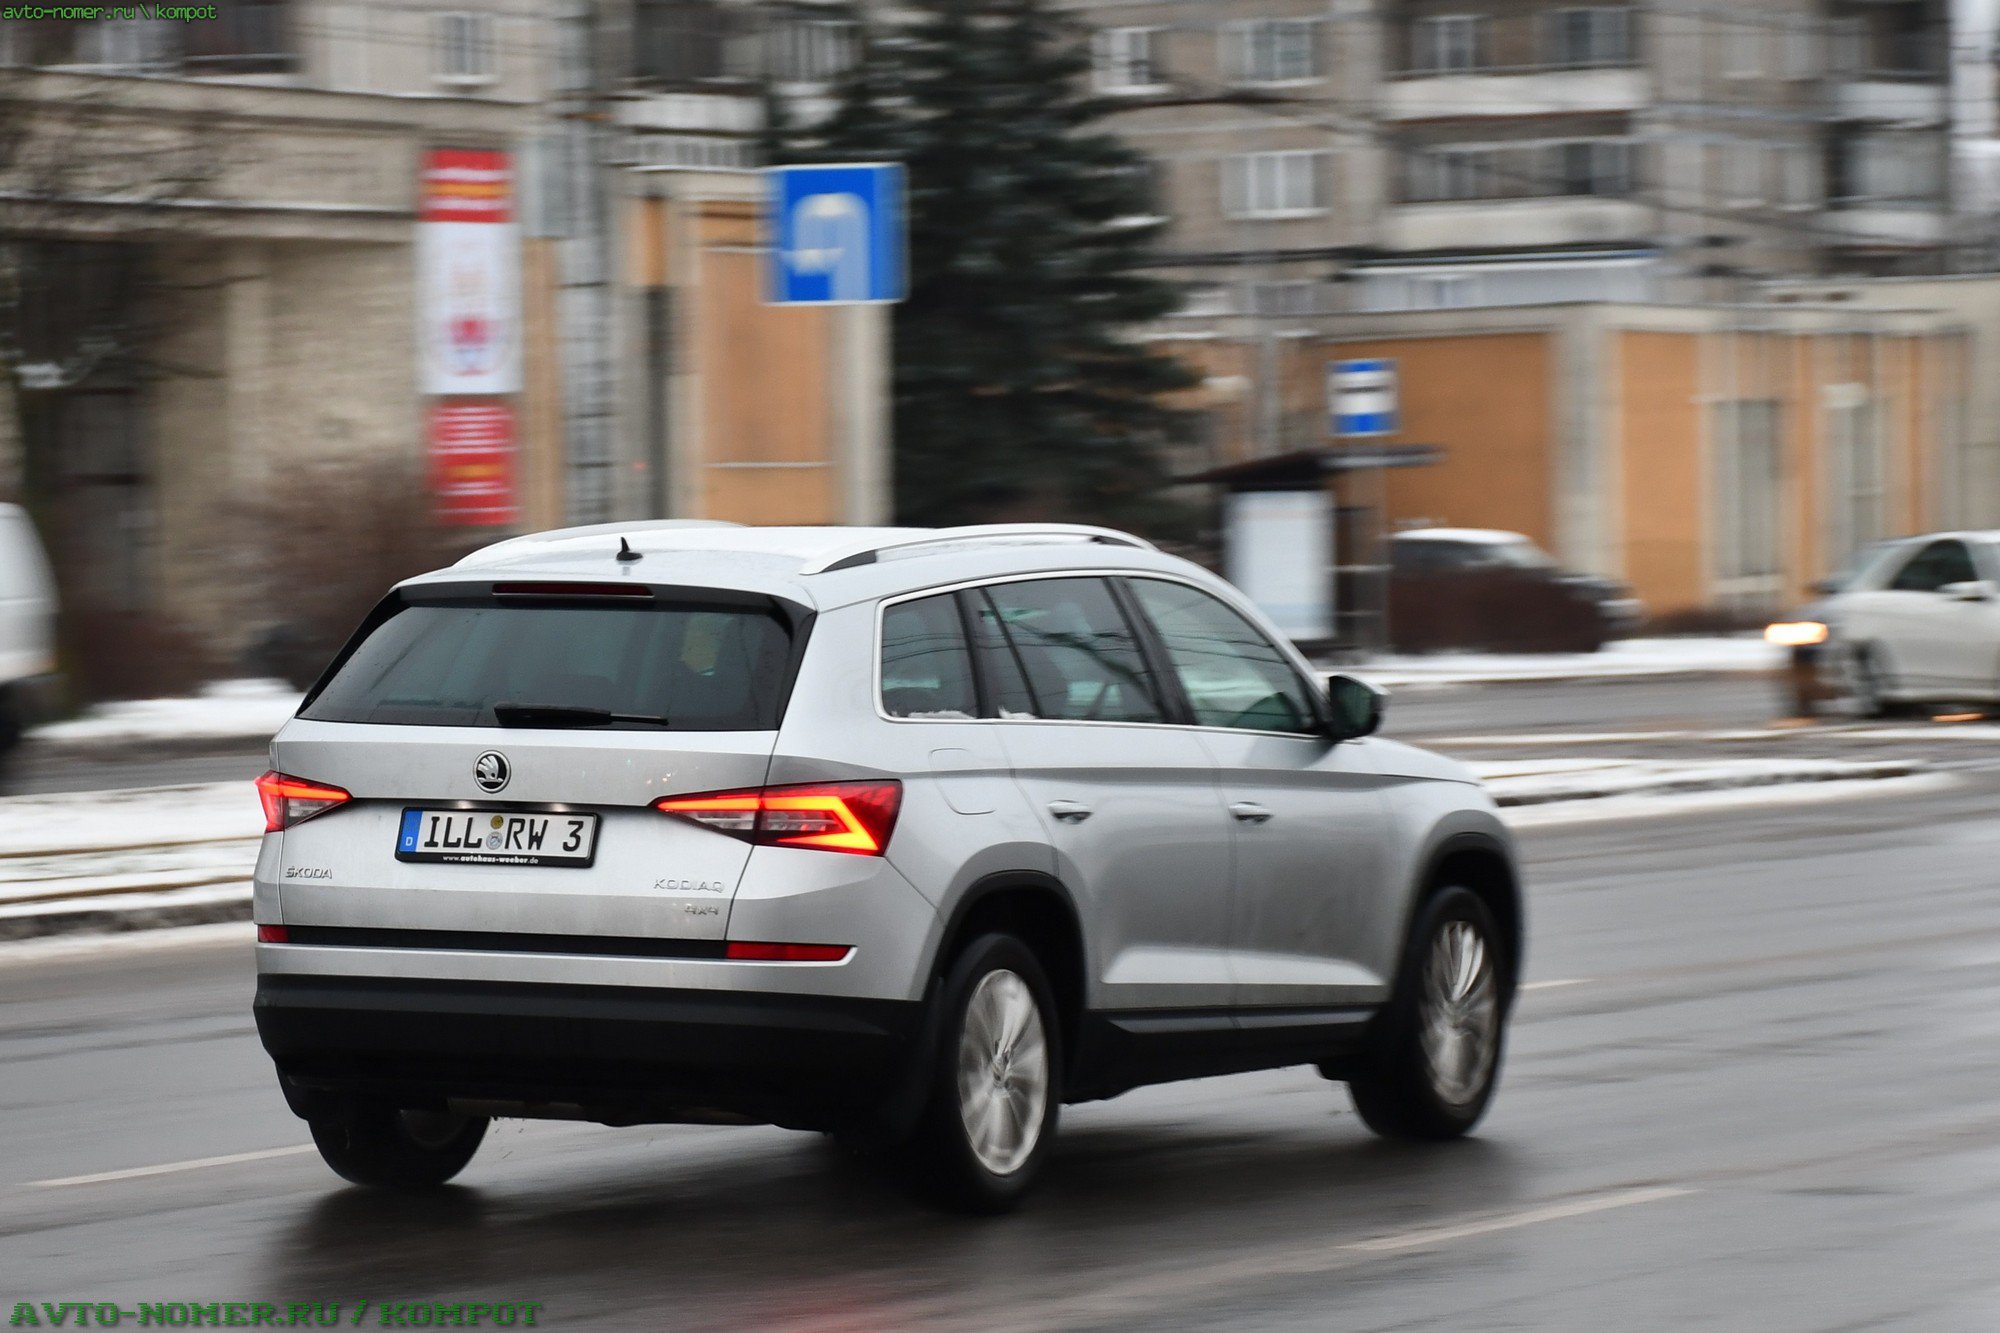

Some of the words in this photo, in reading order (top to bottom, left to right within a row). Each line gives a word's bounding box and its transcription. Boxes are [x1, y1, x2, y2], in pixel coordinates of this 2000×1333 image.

[405, 836, 413, 847] D
[424, 816, 482, 848] ILL
[504, 817, 549, 850] RW
[563, 820, 584, 852] 3
[653, 878, 725, 894] KODIAQ
